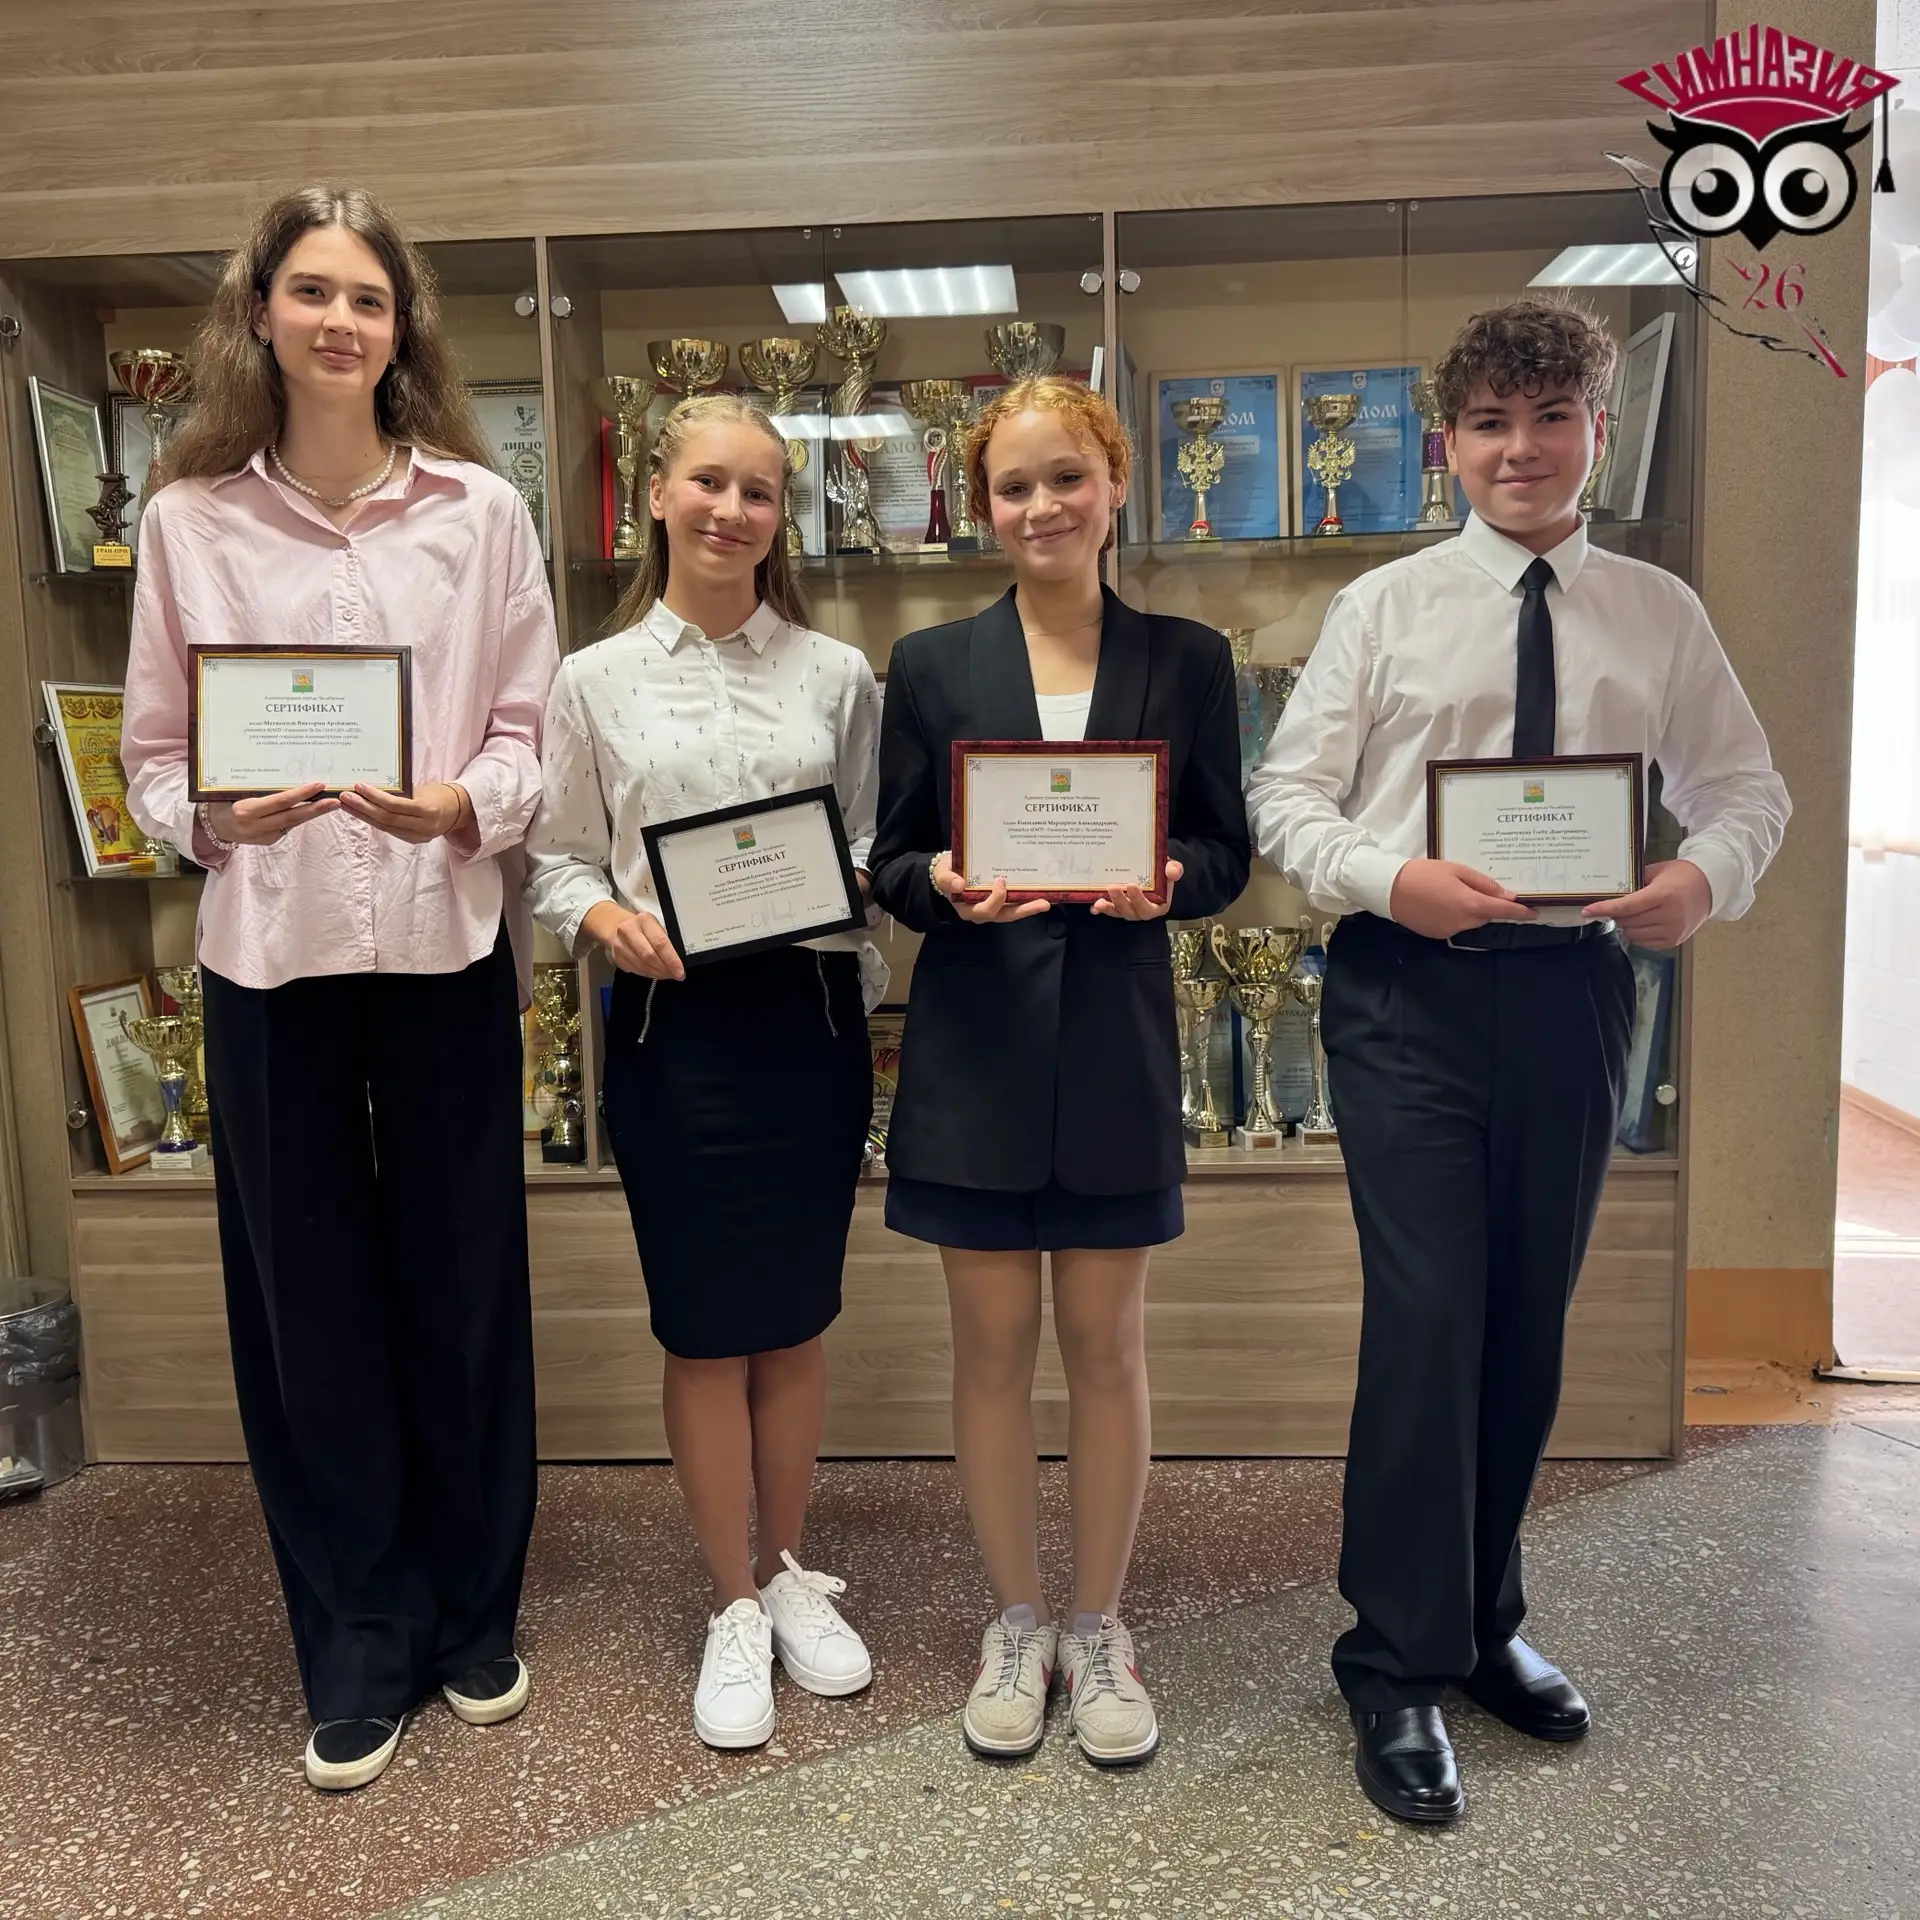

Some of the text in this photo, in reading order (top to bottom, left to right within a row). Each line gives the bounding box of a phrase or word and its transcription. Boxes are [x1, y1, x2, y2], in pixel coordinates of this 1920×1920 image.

[501, 441, 544, 451] ДИПЛО
[265, 703, 345, 713] СЕРТИФИКАТ
[1025, 803, 1100, 813] СЕРТИФИКАТ
[1497, 812, 1575, 823] СЕРТИФИКАТ
[718, 850, 787, 874] СЕРТИФИКАТ
